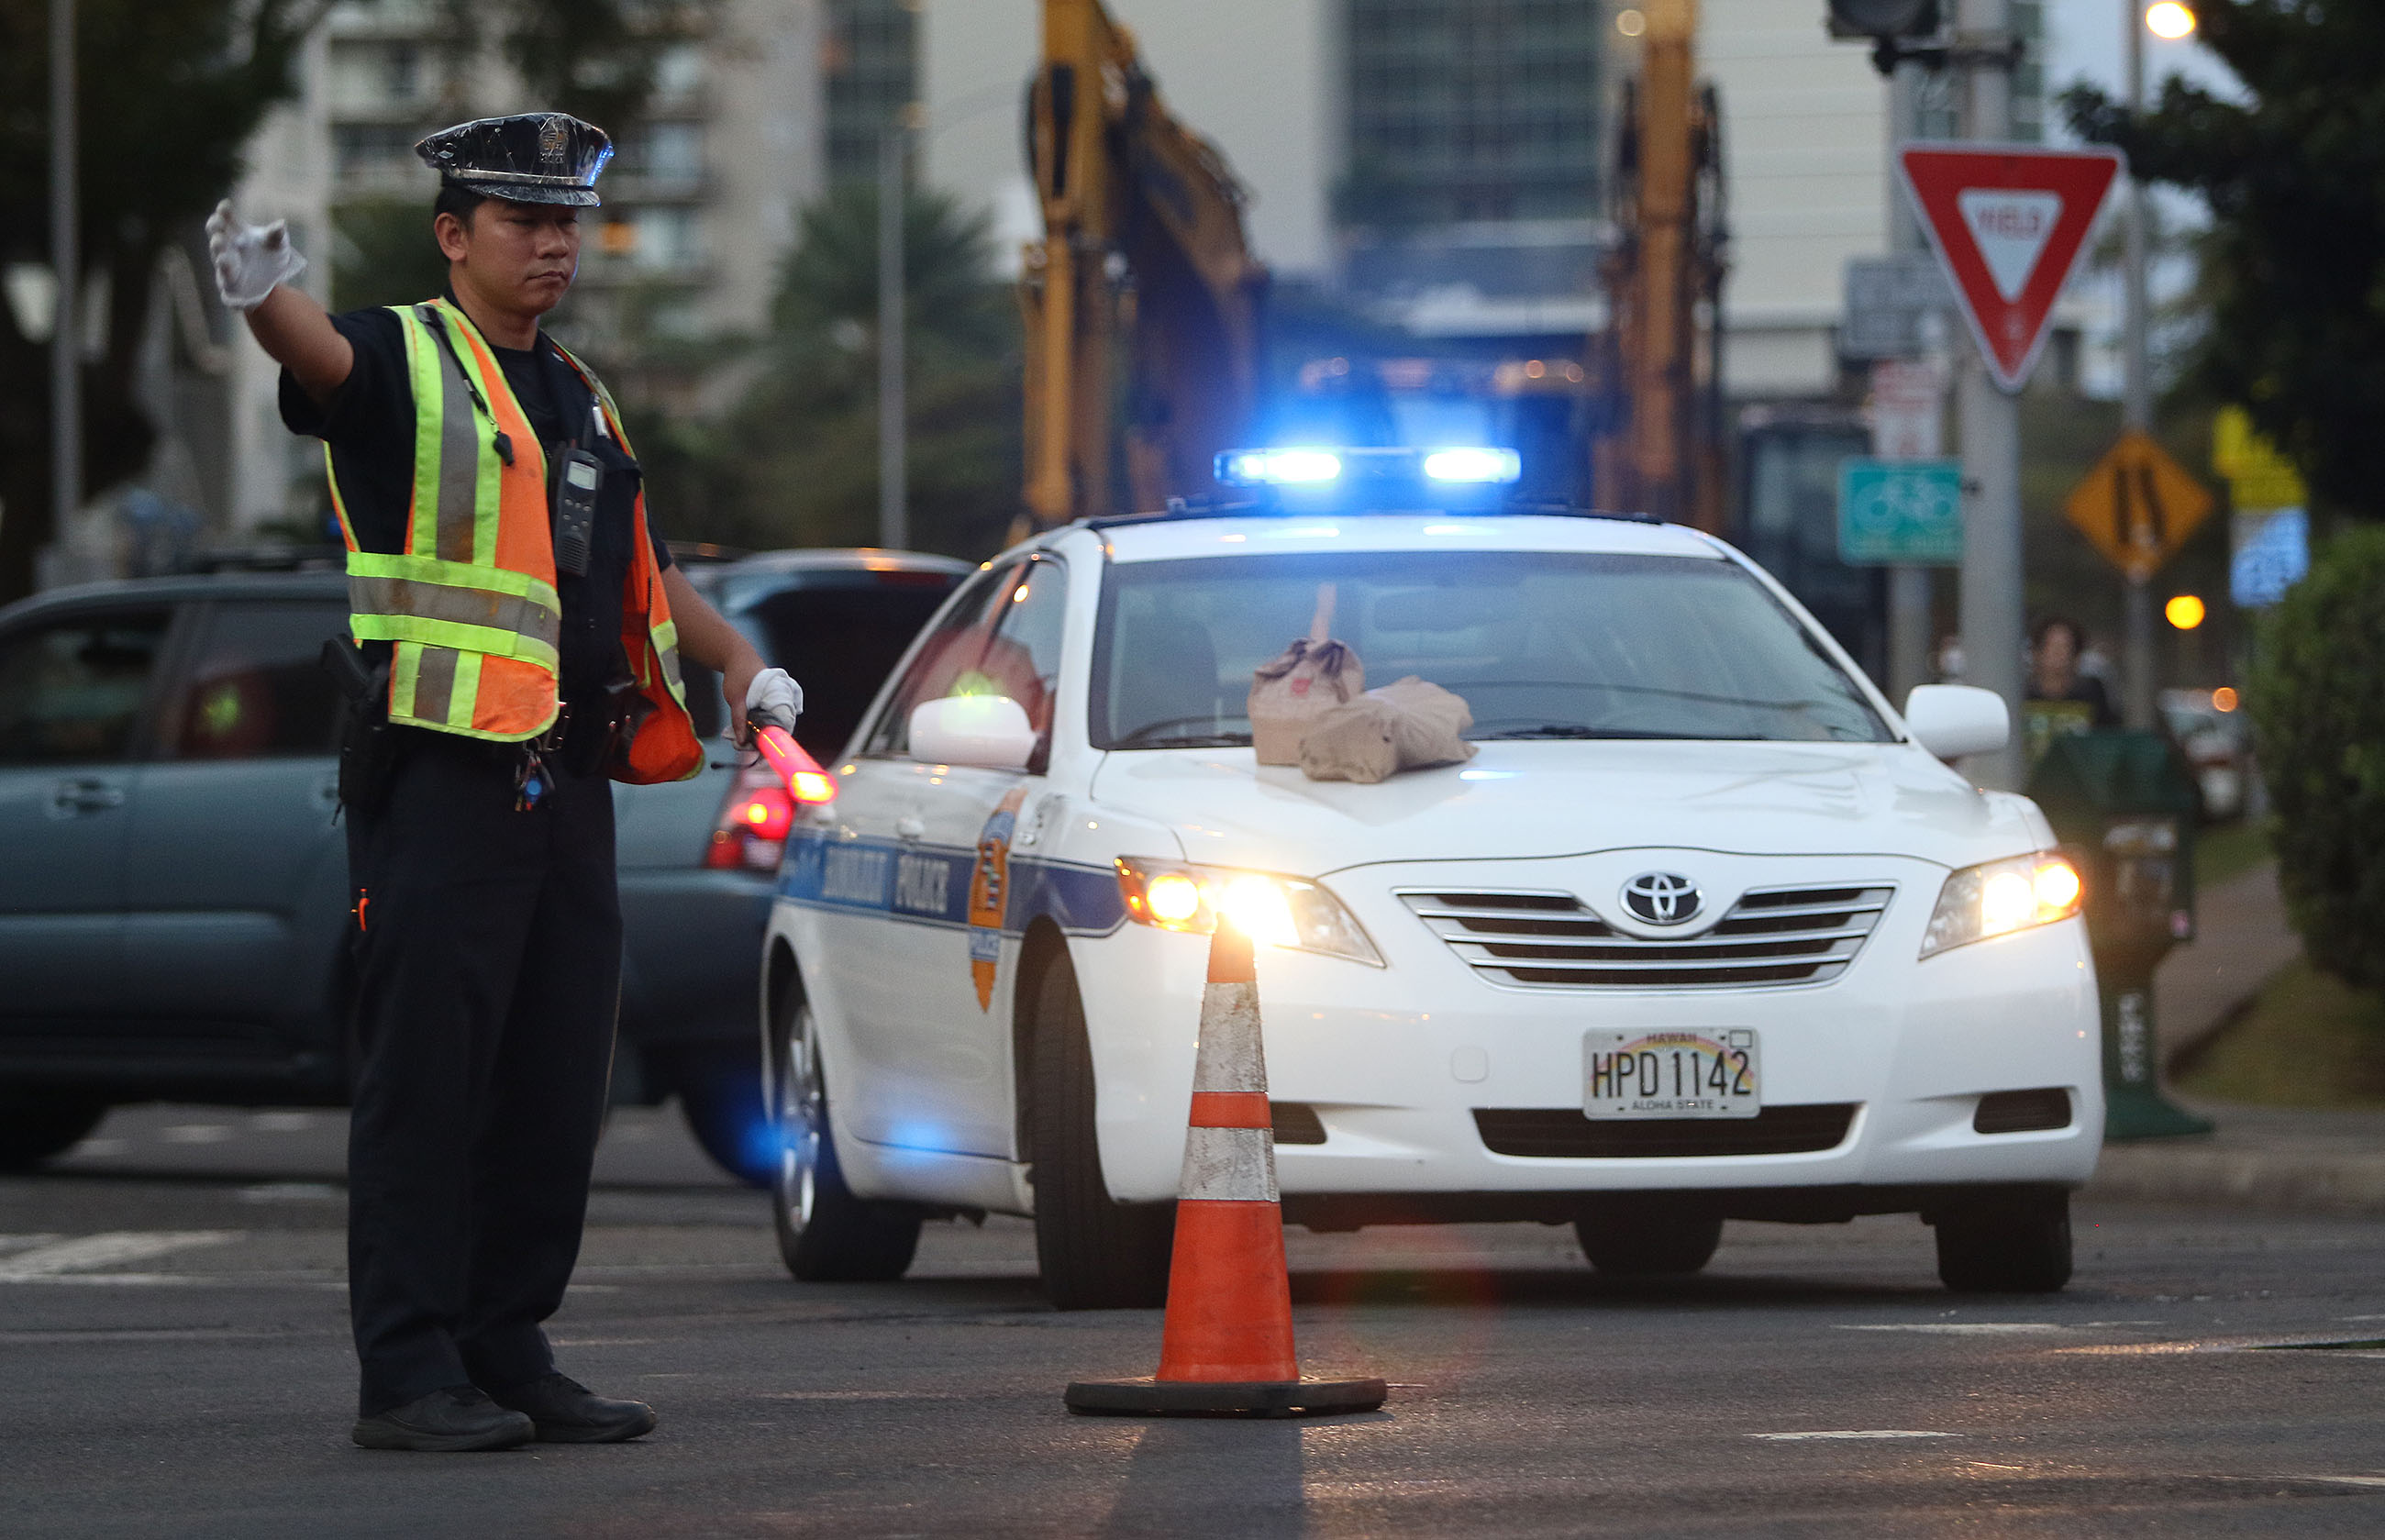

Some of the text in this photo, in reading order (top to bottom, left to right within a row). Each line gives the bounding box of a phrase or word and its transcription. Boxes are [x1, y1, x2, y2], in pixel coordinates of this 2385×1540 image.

[1978, 206, 2042, 240] YIELD
[896, 854, 950, 914] POLICE
[1593, 1050, 1751, 1098] HPD 1142
[1632, 1100, 1714, 1110] ALOHA STATE
